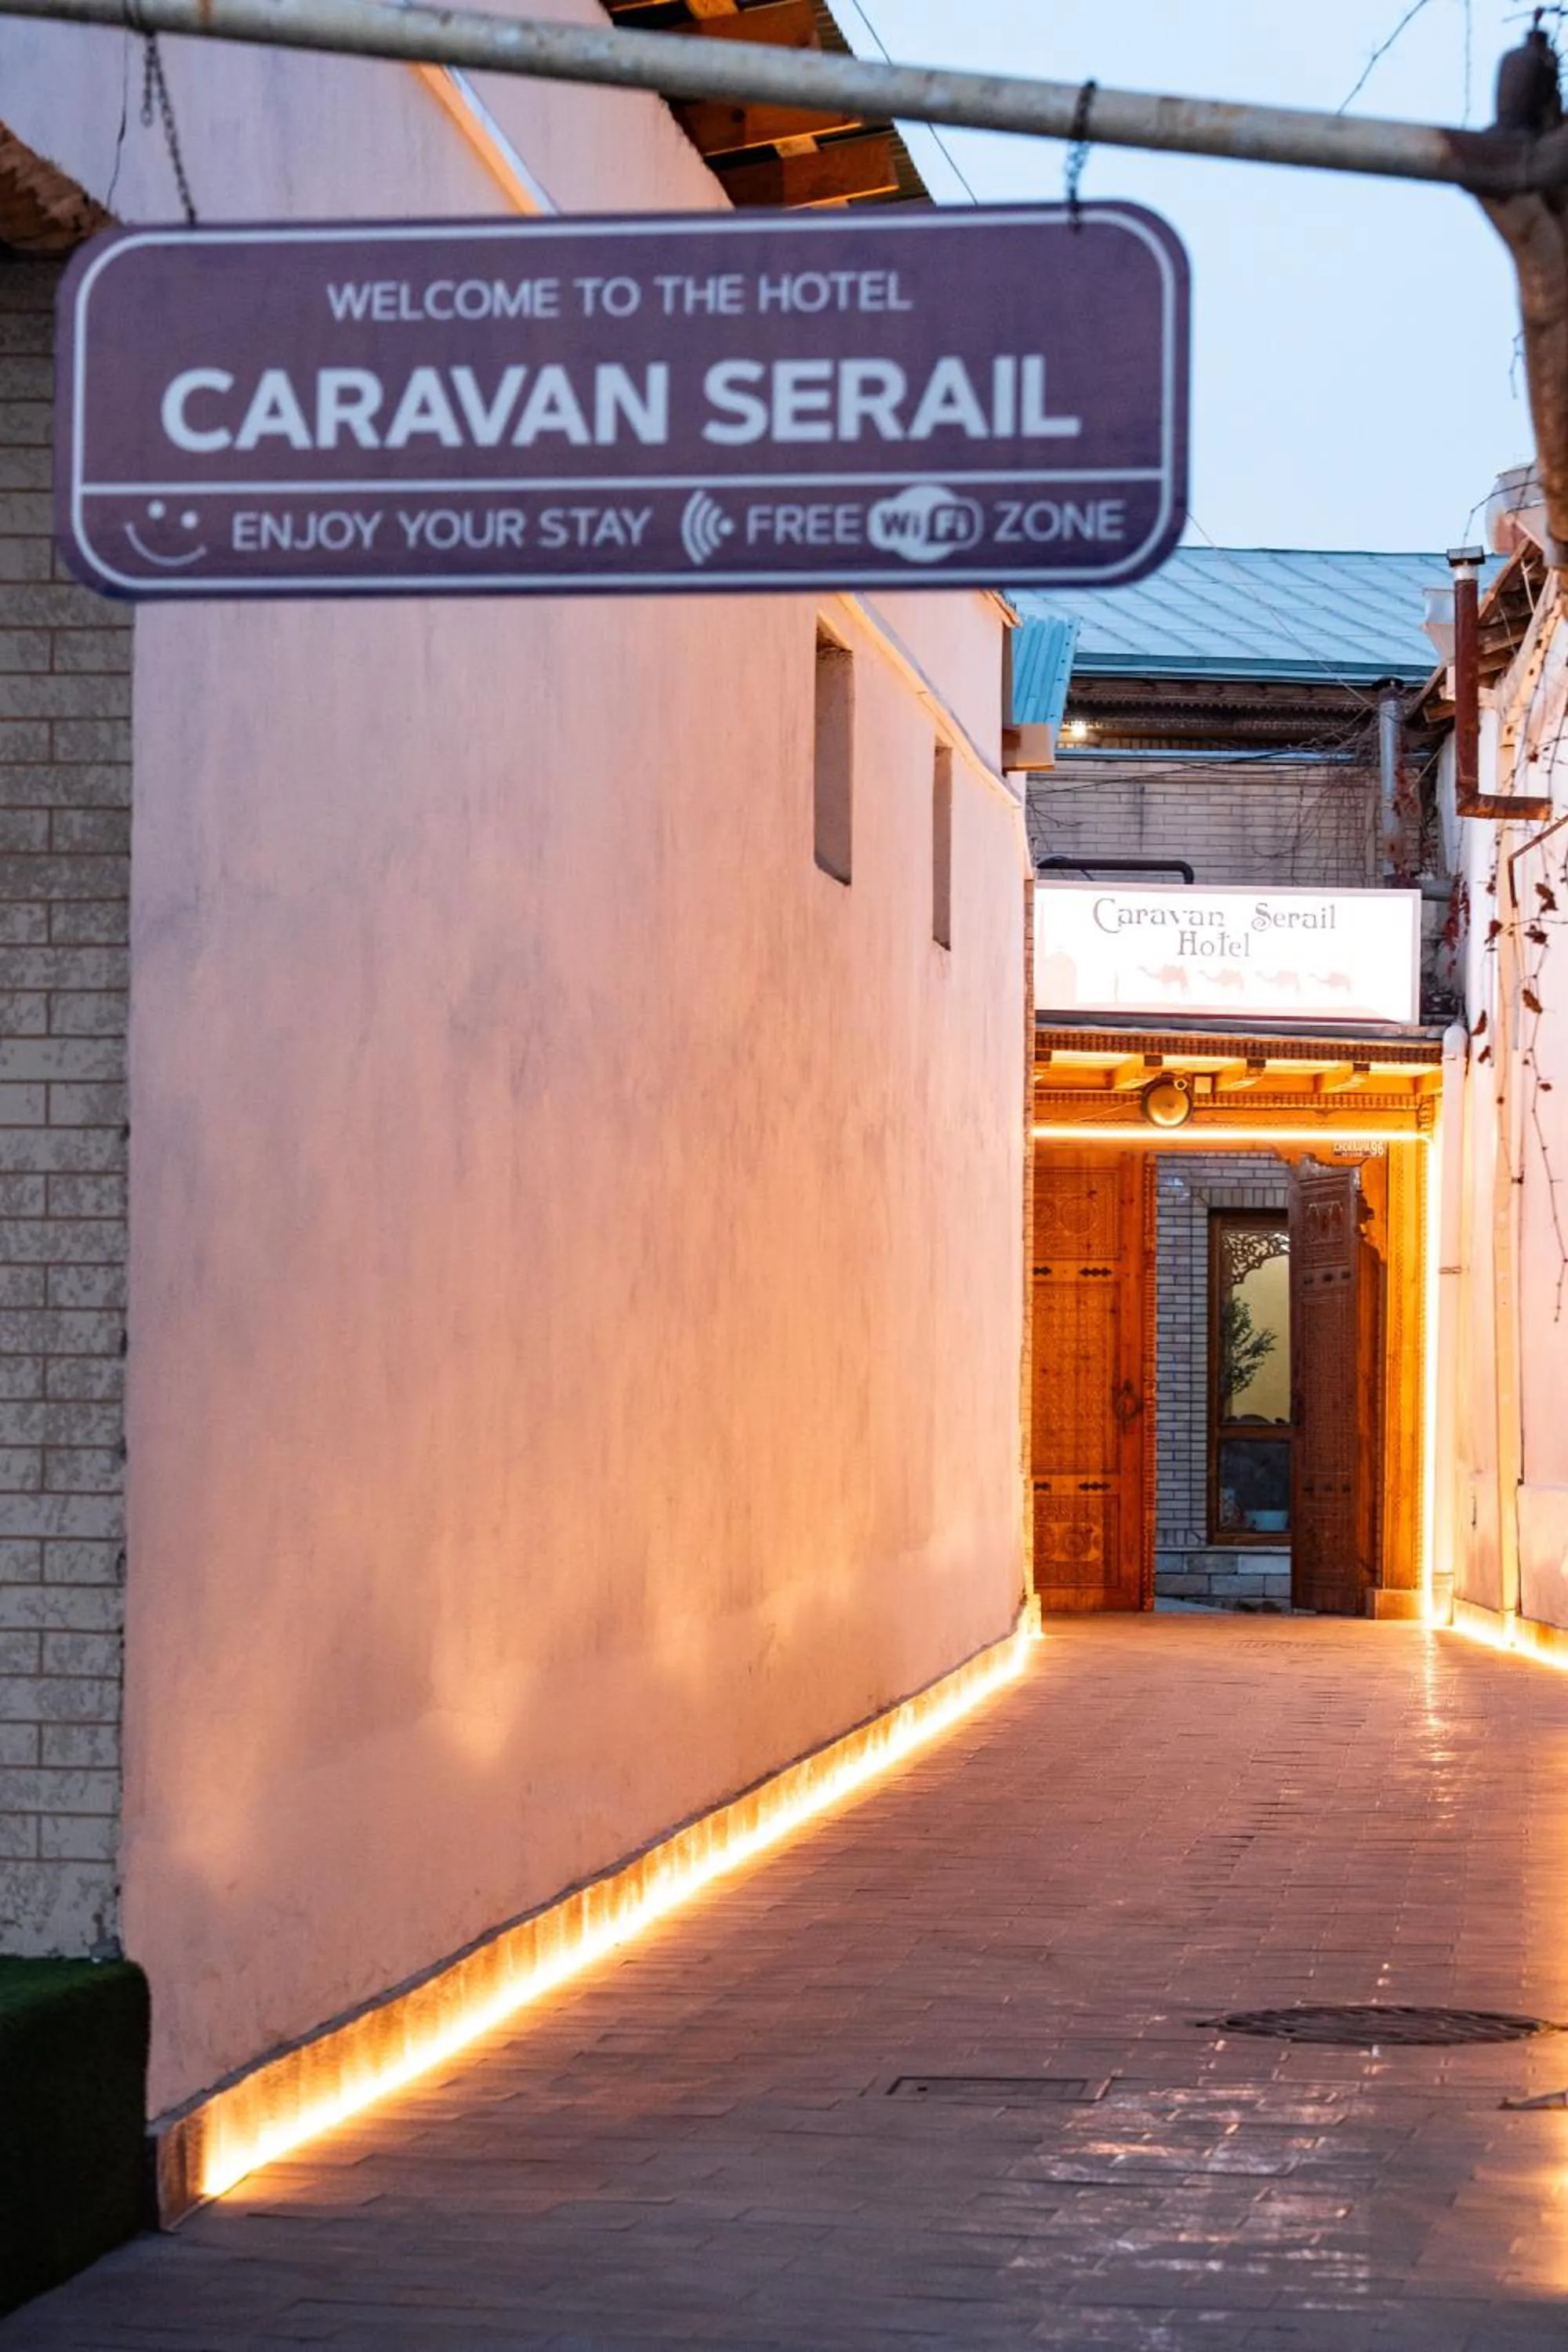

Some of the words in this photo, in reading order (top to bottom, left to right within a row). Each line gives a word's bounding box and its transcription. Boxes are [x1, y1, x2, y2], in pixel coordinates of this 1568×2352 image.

[326, 278, 560, 321] WELCOME
[573, 276, 641, 317] TO
[654, 274, 746, 314] THE
[758, 270, 913, 313] HOTEL
[161, 362, 669, 452] CARAVAN
[702, 354, 1082, 445] SERAIL
[232, 511, 382, 550] ENJOY
[397, 510, 526, 548] YOUR
[539, 507, 652, 546] STAY
[746, 504, 861, 545] FREE
[993, 499, 1126, 542] ZONE
[1093, 898, 1225, 934] Caravan
[1251, 902, 1336, 932] Serail
[1177, 931, 1250, 957] Hotel
